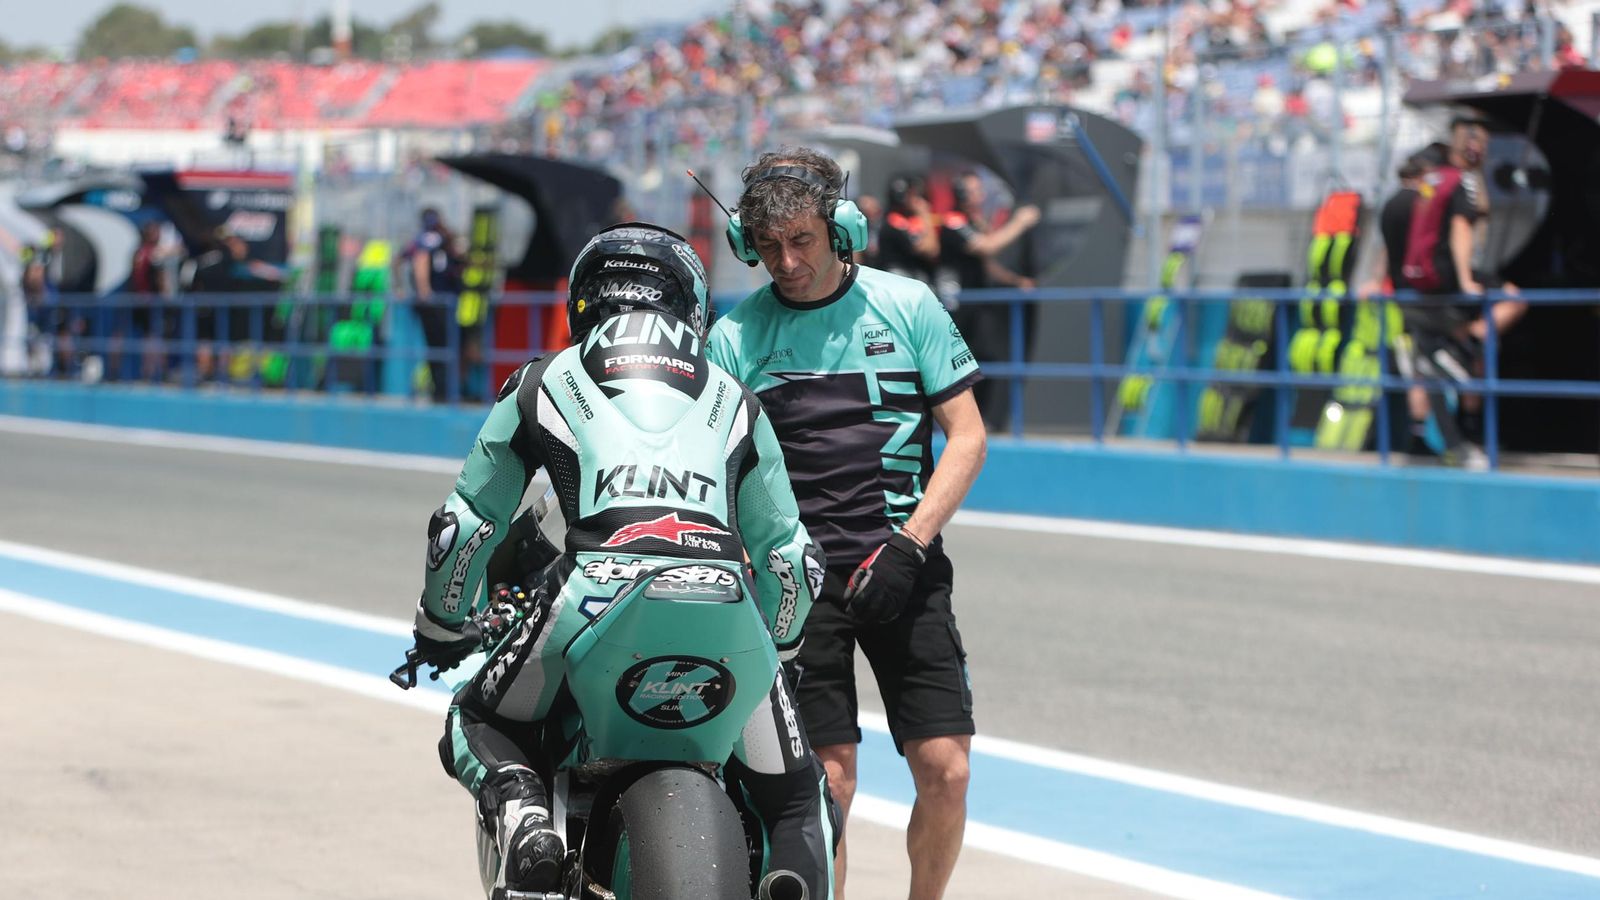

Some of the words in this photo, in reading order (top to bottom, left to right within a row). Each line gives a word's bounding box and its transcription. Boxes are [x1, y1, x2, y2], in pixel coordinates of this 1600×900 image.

[604, 259, 660, 273] Kabuto
[598, 280, 663, 302] NAVARRO
[583, 313, 699, 359] KLINT
[864, 328, 890, 340] KLINT
[604, 354, 695, 374] FORWARD
[604, 363, 659, 375] FACTORY
[665, 366, 696, 380] TEAM
[562, 369, 594, 421] FORWARD
[706, 380, 727, 430] FORWARD
[593, 464, 718, 508] KLINT
[441, 518, 496, 615] alpinestars
[767, 546, 801, 639] alpinestars
[642, 681, 711, 695] KLINT
[660, 704, 684, 712] SLIM
